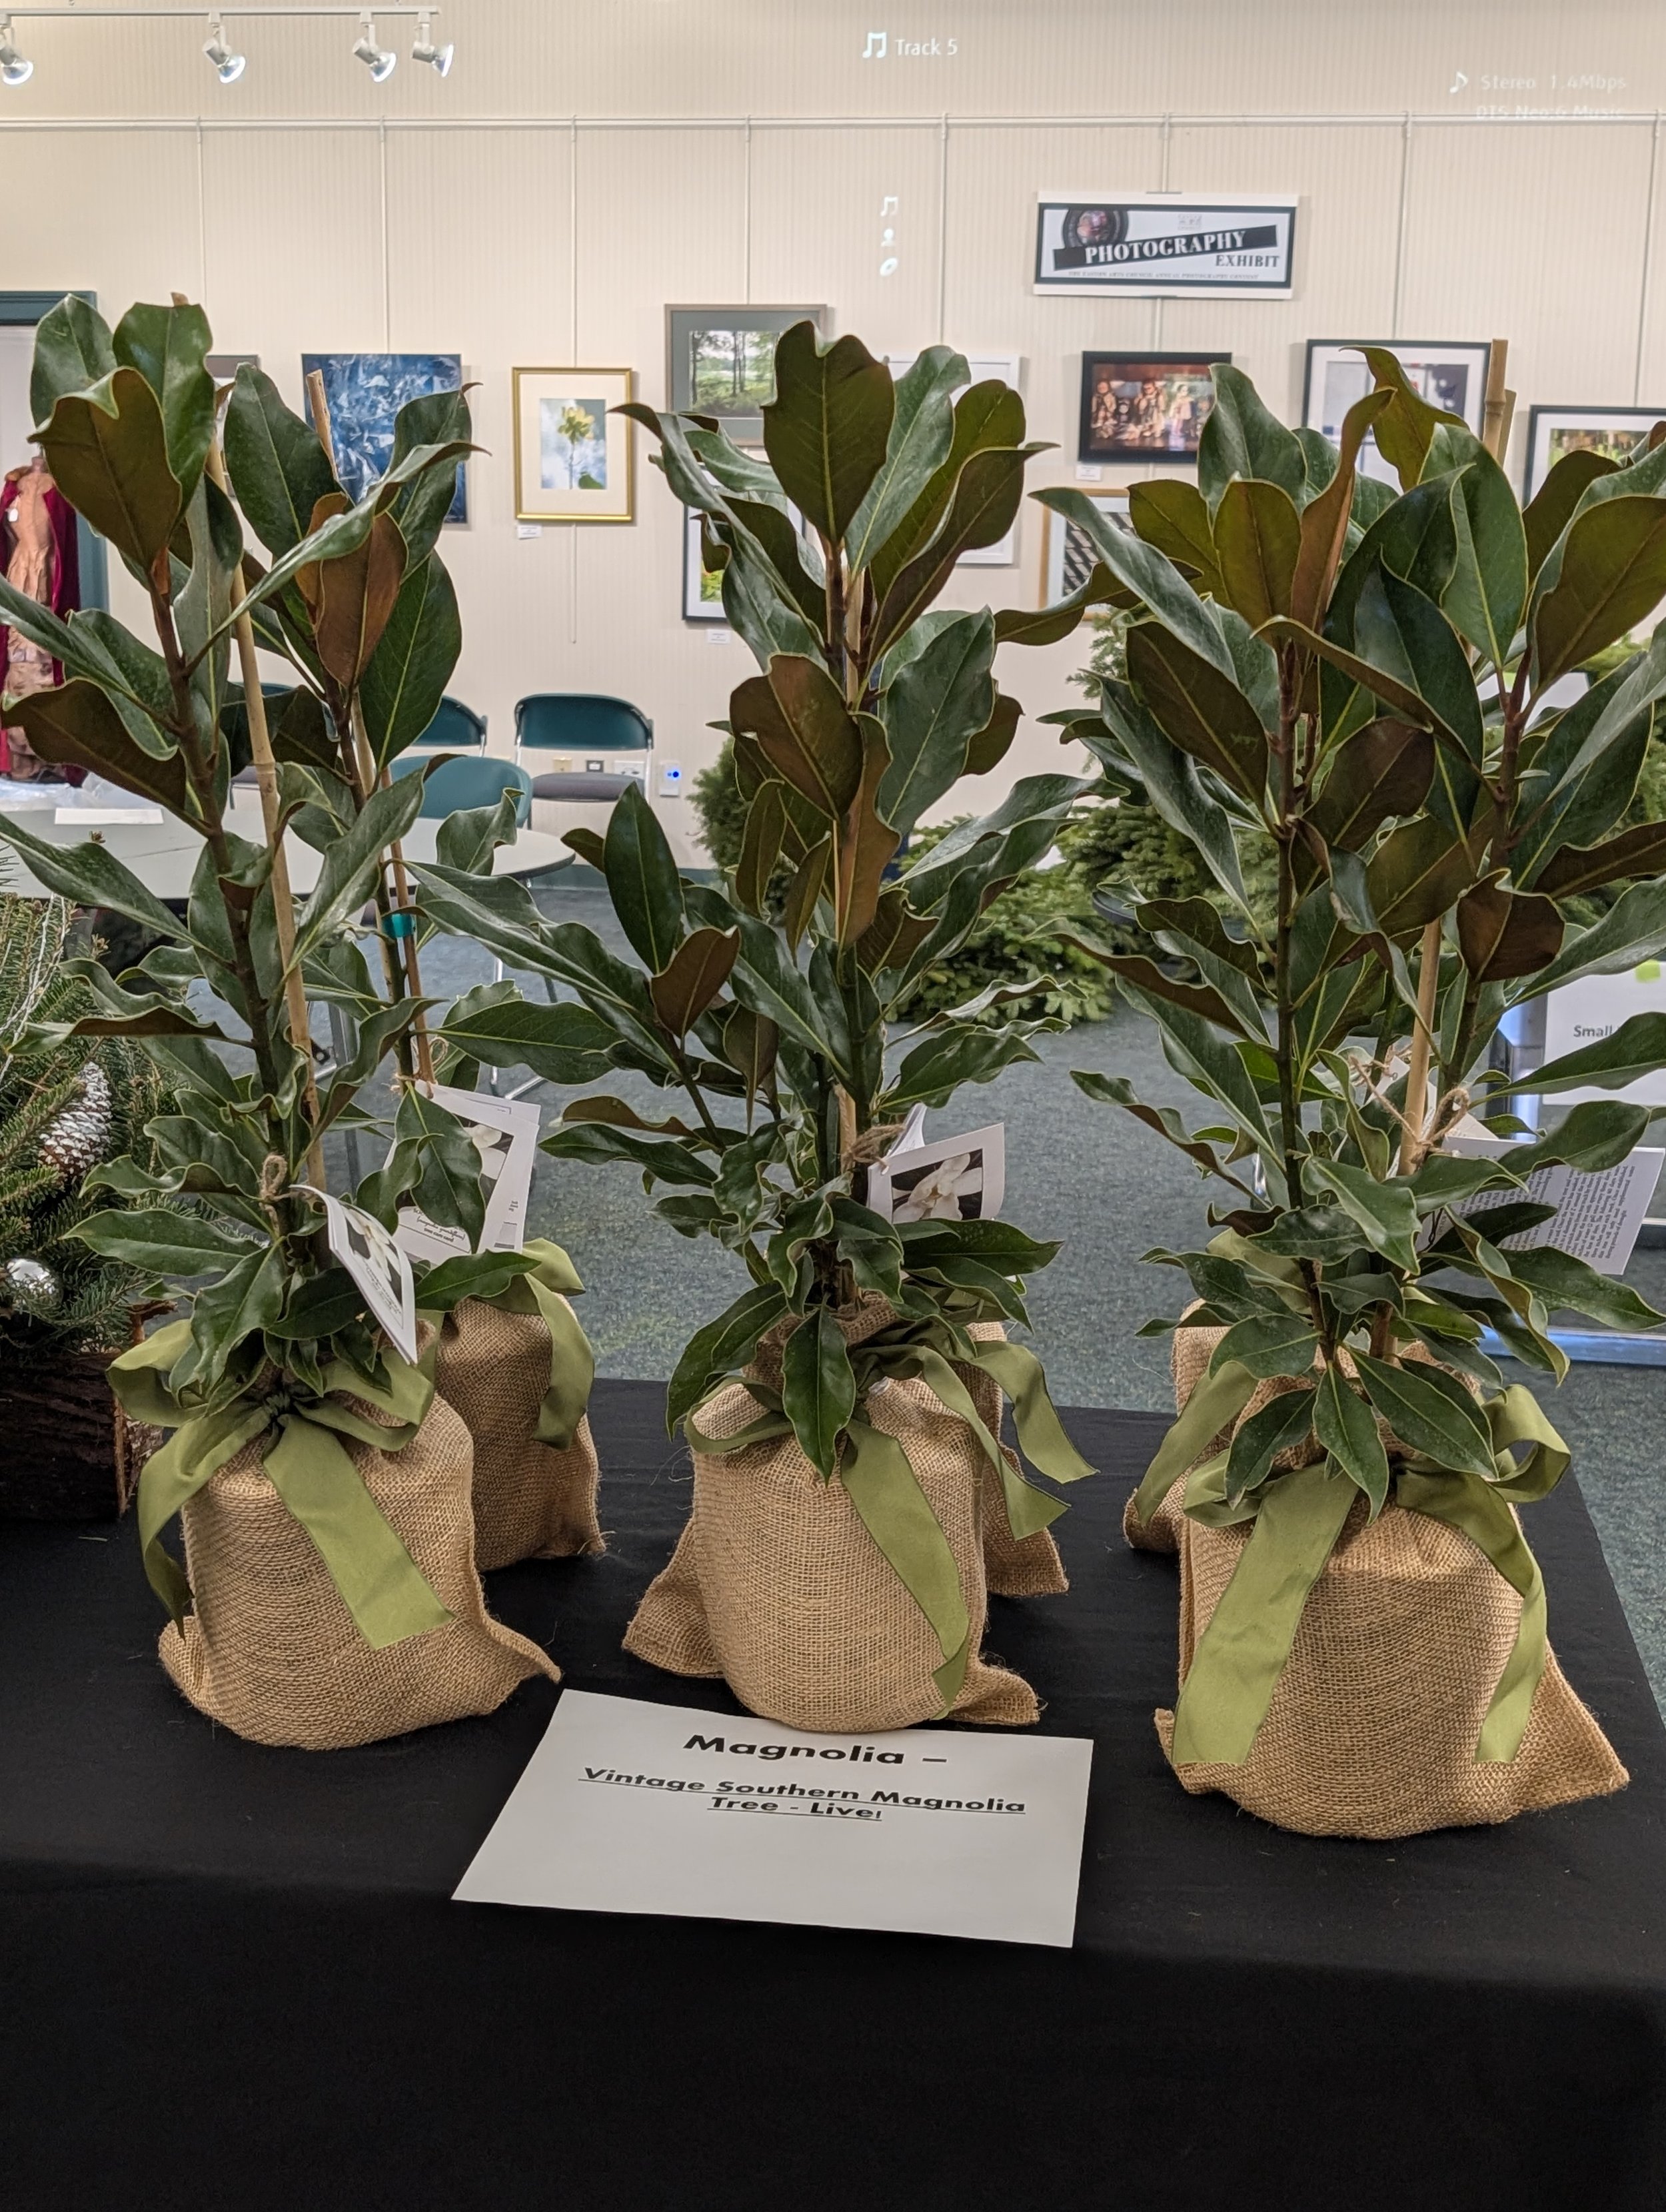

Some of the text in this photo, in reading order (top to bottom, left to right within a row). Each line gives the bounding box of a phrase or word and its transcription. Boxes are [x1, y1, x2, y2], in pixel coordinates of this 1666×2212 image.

[895, 38, 958, 56] Track 5
[1481, 74, 1627, 94] Stereo 1.4Mbps
[1085, 230, 1246, 265] PHOTOGRAPHY
[1215, 255, 1280, 268] EXHIBIT
[1573, 1025, 1613, 1037] Small
[682, 1734, 906, 1765] Magnolia
[584, 1767, 1026, 1810] Vintage Southern Magnolia
[710, 1796, 779, 1812] Tree
[810, 1802, 882, 1820] Live!
